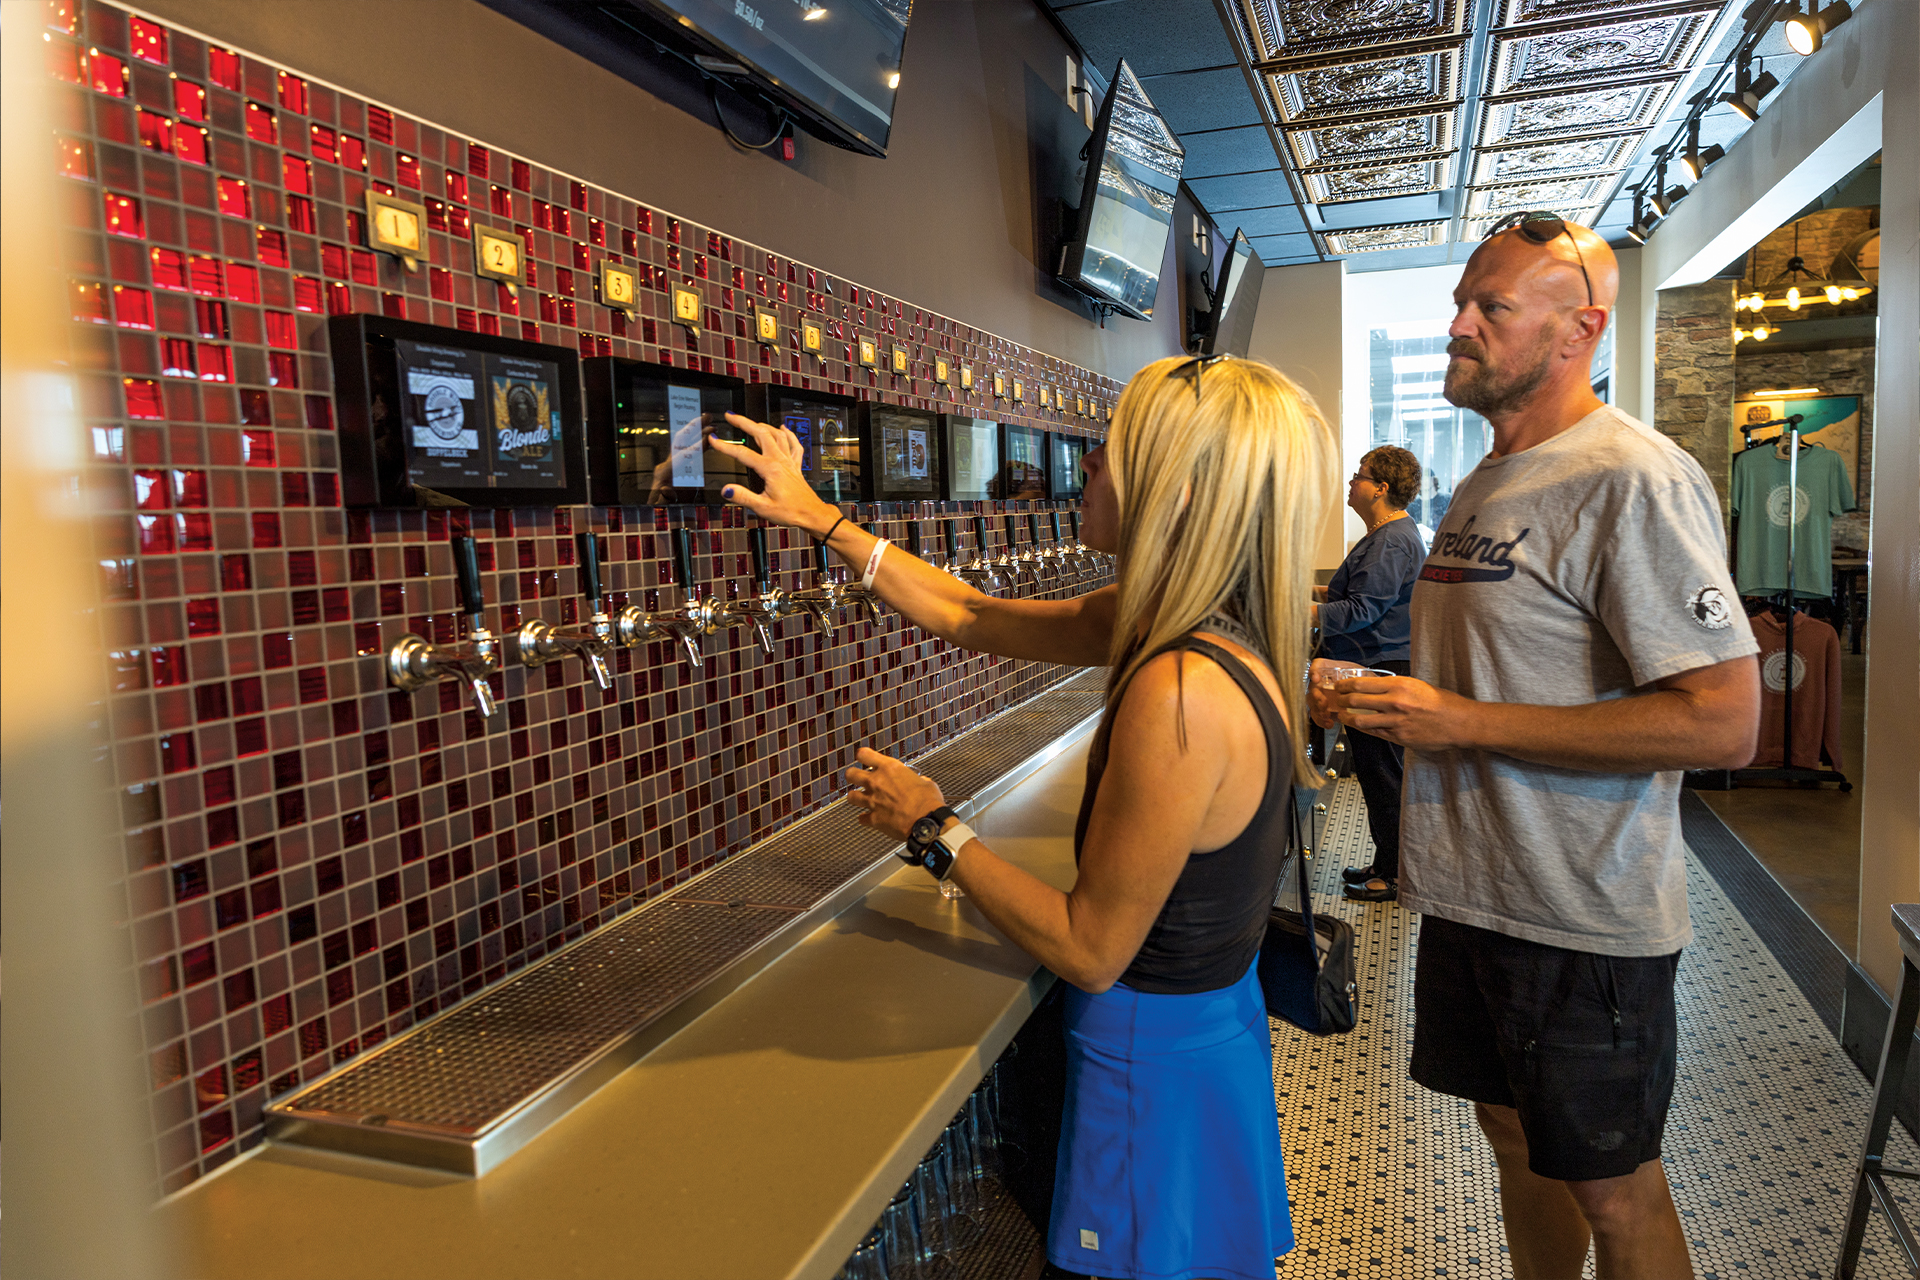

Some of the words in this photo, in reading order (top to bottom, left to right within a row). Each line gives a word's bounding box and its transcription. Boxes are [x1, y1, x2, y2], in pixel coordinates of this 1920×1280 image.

[393, 215, 399, 238] 1
[494, 244, 503, 266] 2
[615, 277, 622, 296] 3
[683, 296, 690, 314] 4
[764, 318, 770, 334] 5
[809, 330, 815, 345] 6
[498, 425, 551, 451] Blonde
[522, 446, 543, 457] ALE
